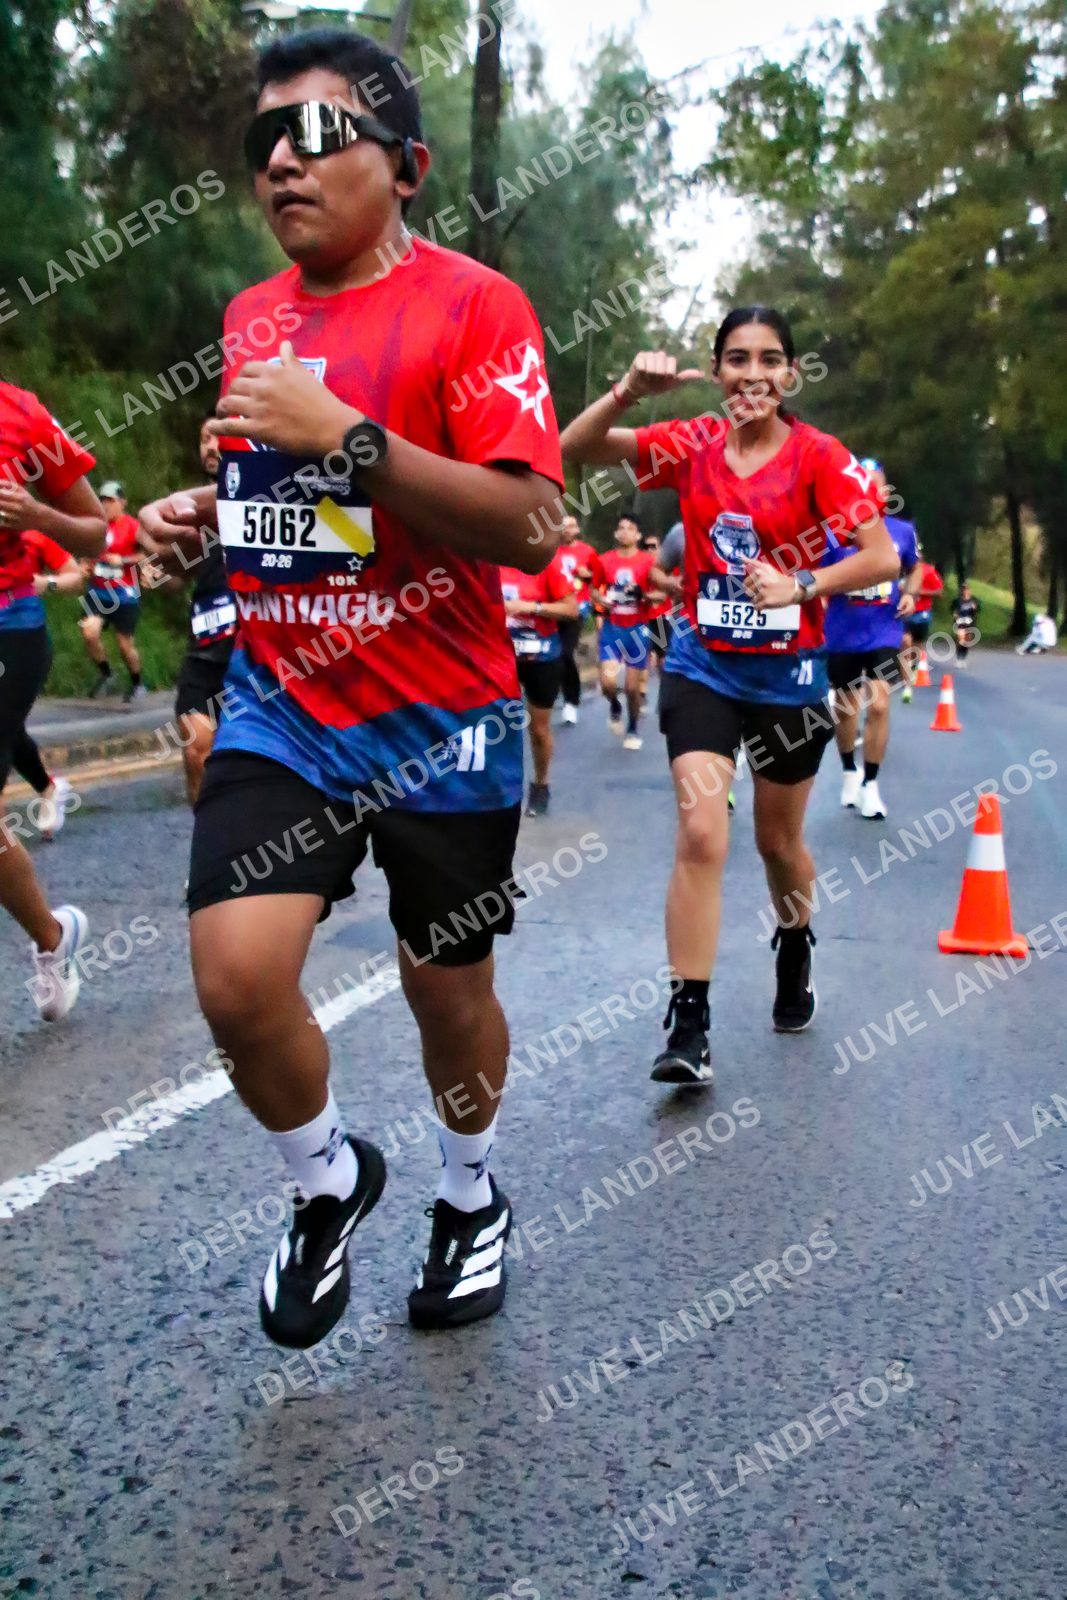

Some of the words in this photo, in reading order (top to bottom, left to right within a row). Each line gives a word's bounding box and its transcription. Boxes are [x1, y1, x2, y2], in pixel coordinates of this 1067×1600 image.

[243, 505, 317, 548] 5062
[261, 553, 293, 568] 20-26
[327, 575, 358, 586] 10K
[720, 603, 768, 628] 5525
